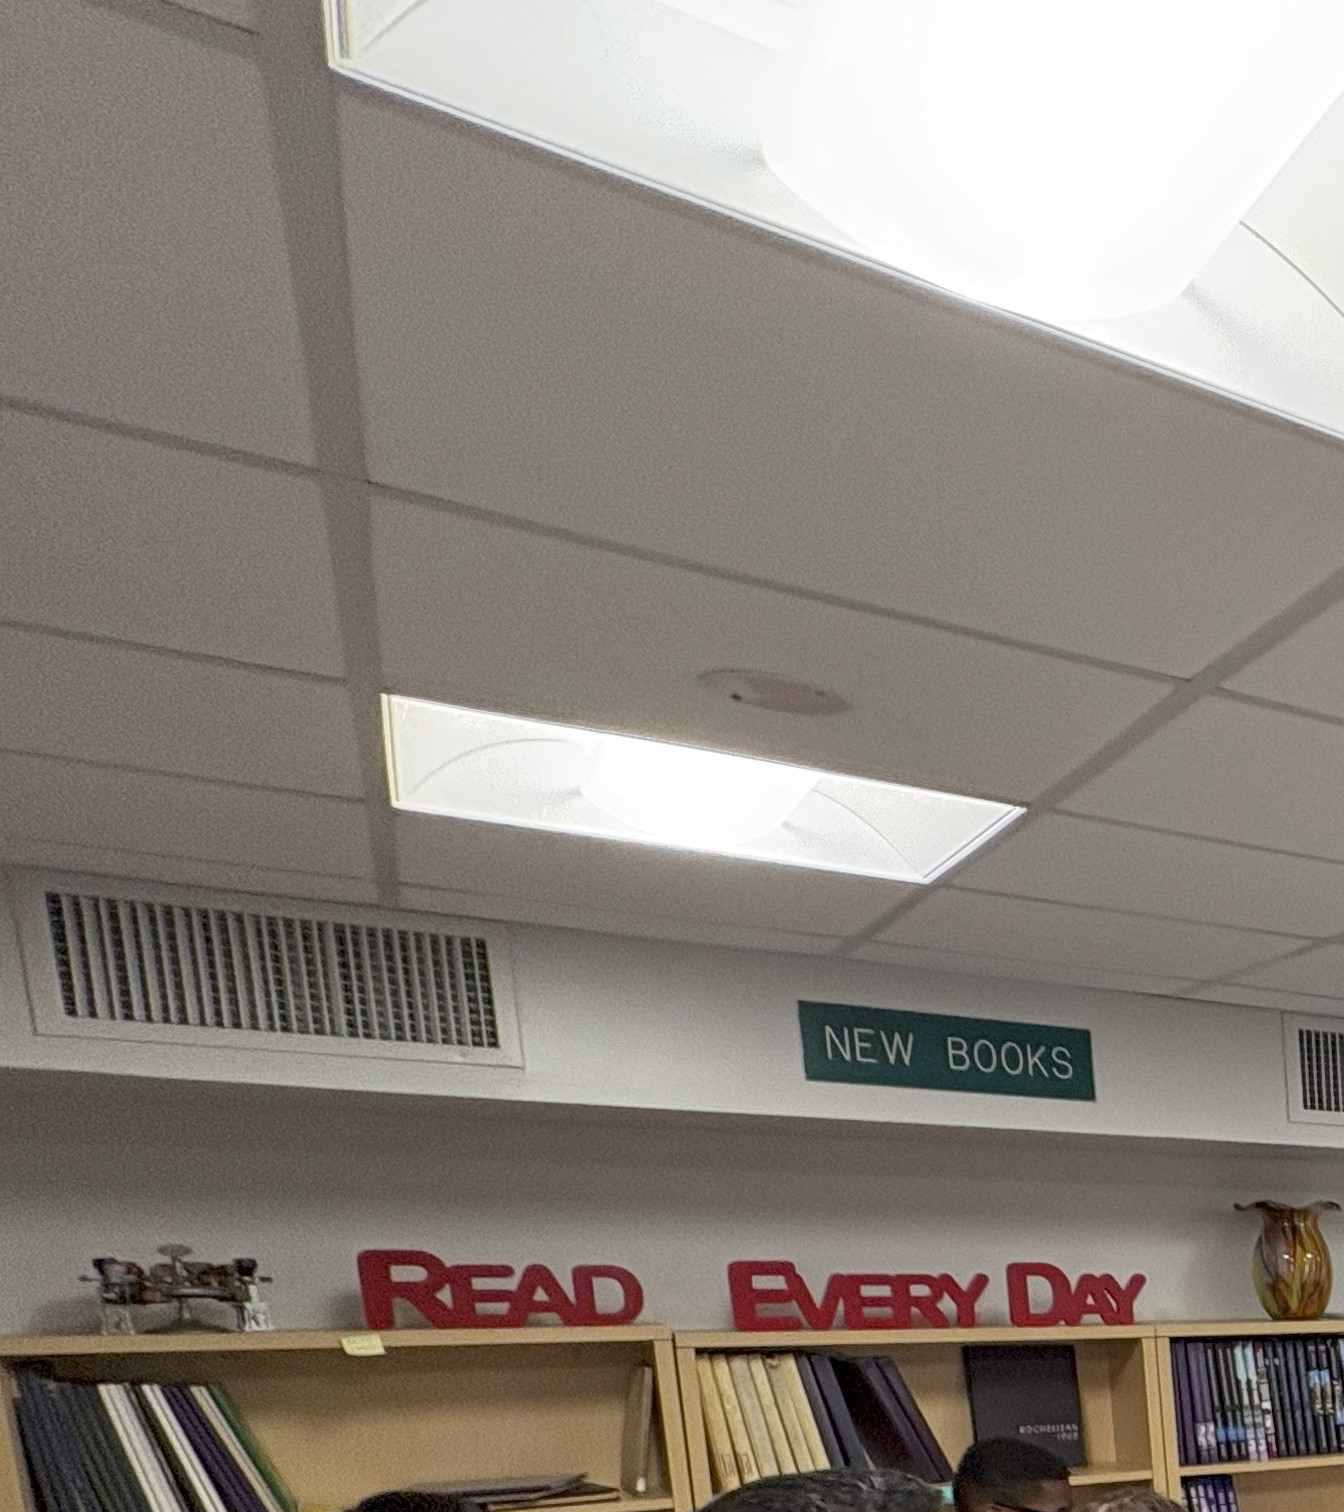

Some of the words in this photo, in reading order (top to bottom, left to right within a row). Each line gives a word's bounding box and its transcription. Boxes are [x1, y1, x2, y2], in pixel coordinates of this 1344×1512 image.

[824, 1024, 914, 1067] NEW
[947, 1036, 1074, 1081] BOOKS
[357, 1249, 644, 1331] READ
[727, 1260, 989, 1332] EVERY
[1006, 1262, 1147, 1328] DAY
